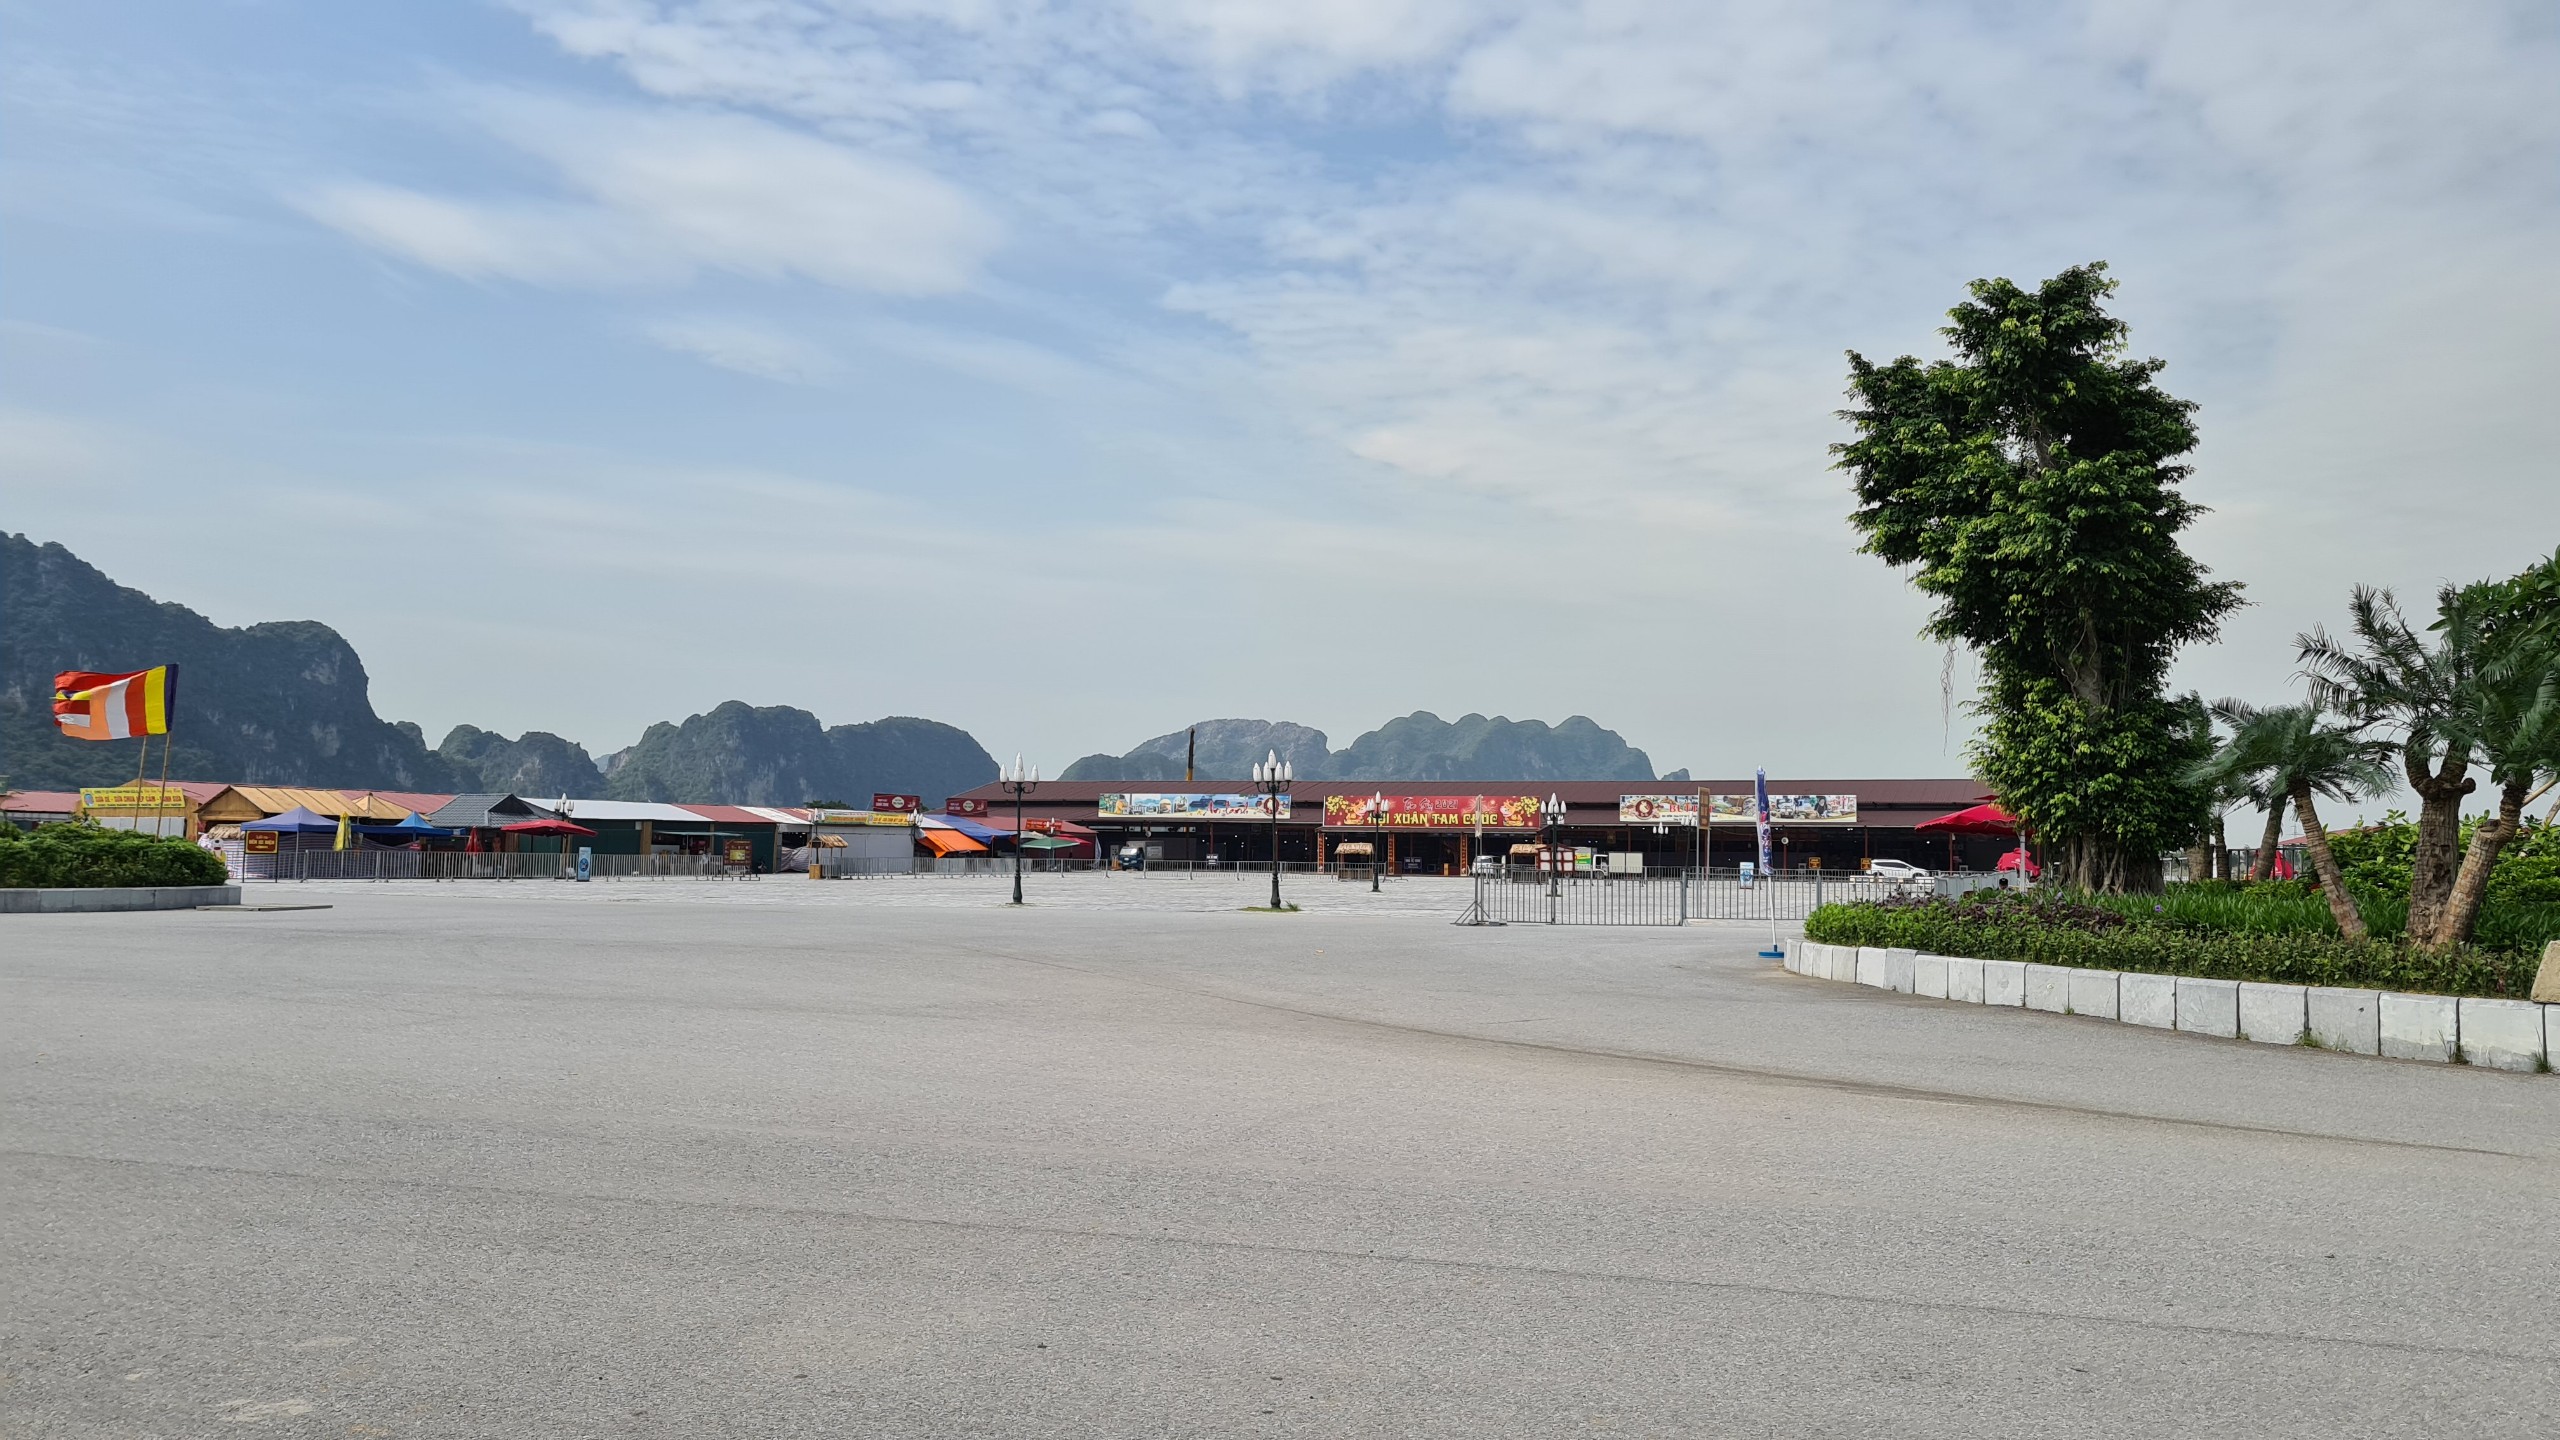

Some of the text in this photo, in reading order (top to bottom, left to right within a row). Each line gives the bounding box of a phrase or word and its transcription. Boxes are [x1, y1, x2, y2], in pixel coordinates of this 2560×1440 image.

[1435, 799, 1458, 810] 2021
[1394, 812, 1428, 824] XUÂN
[1432, 814, 1458, 824] TAM
